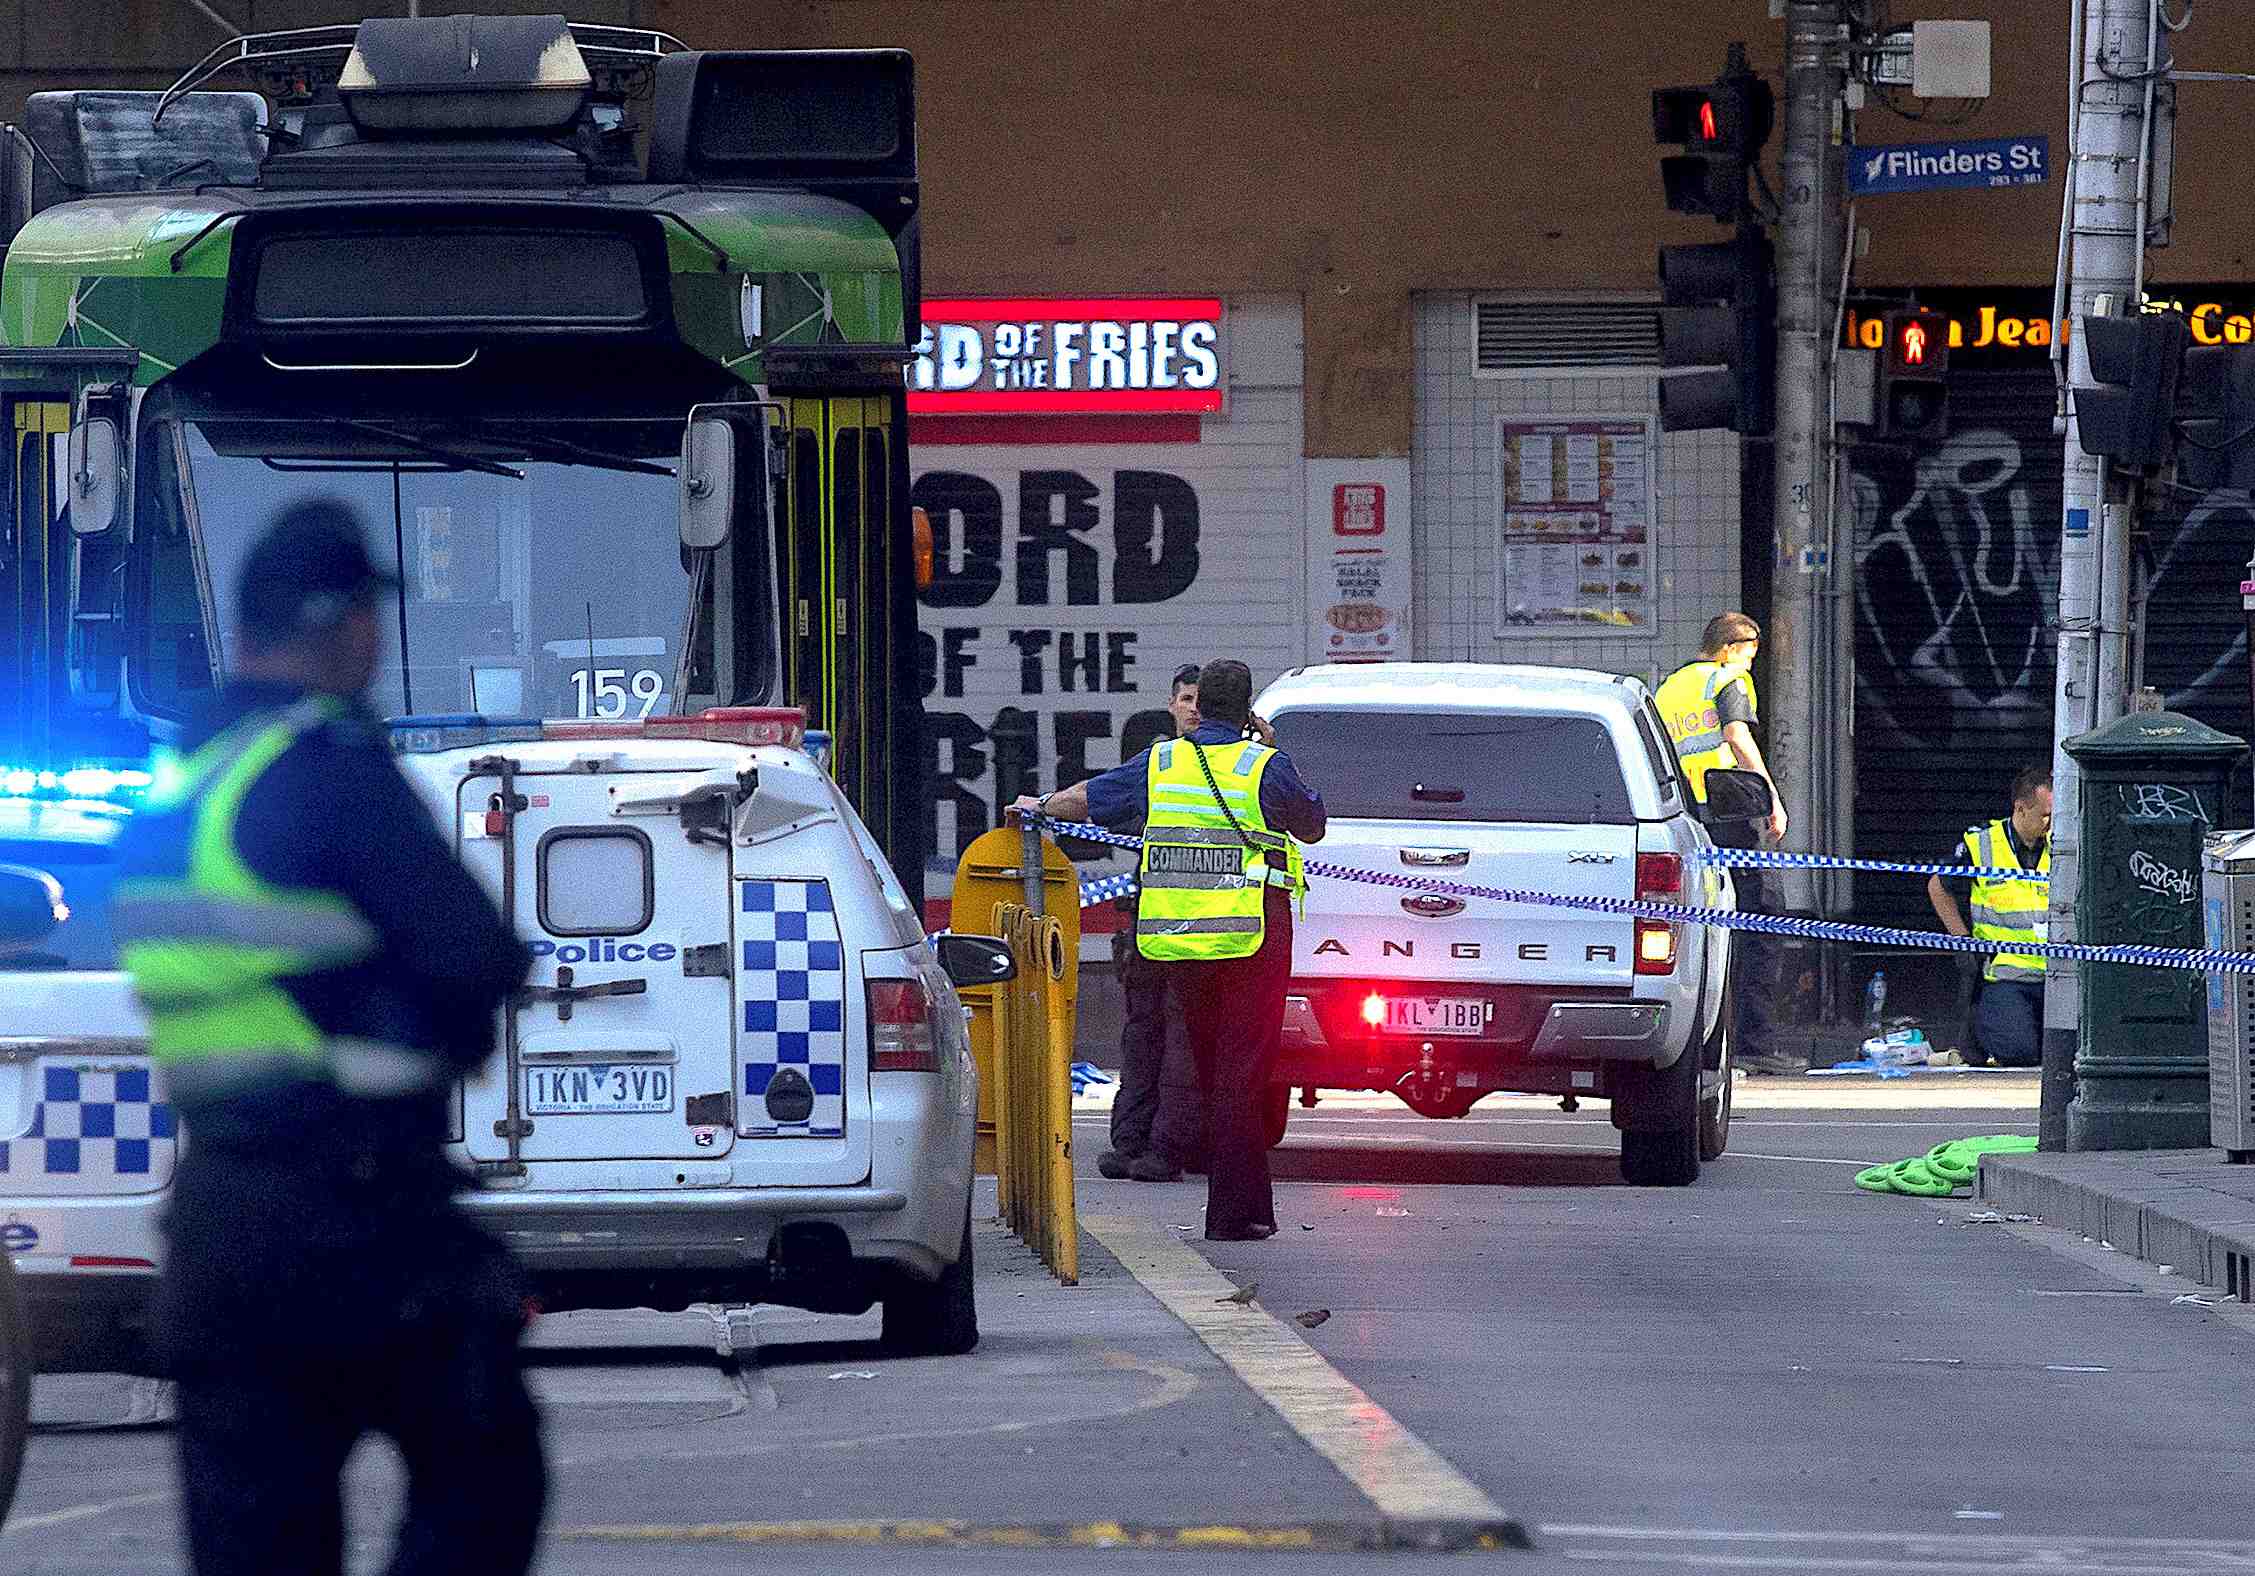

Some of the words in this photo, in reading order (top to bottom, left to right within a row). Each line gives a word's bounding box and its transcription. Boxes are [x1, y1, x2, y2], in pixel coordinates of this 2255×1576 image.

[1888, 149, 2003, 177] Flinders
[2009, 144, 2042, 170] St
[994, 323, 1043, 357] OF
[1053, 321, 1220, 389] FRIES
[989, 357, 1048, 389] THE
[1008, 629, 1138, 694] THE
[570, 668, 663, 720] 159
[1150, 846, 1240, 873] COMMANDER
[527, 939, 677, 963] Police
[1386, 1000, 1422, 1025] 1KL
[1444, 1003, 1480, 1027] 1BB
[536, 1072, 588, 1103] 1KN
[612, 1070, 668, 1101] 3VD
